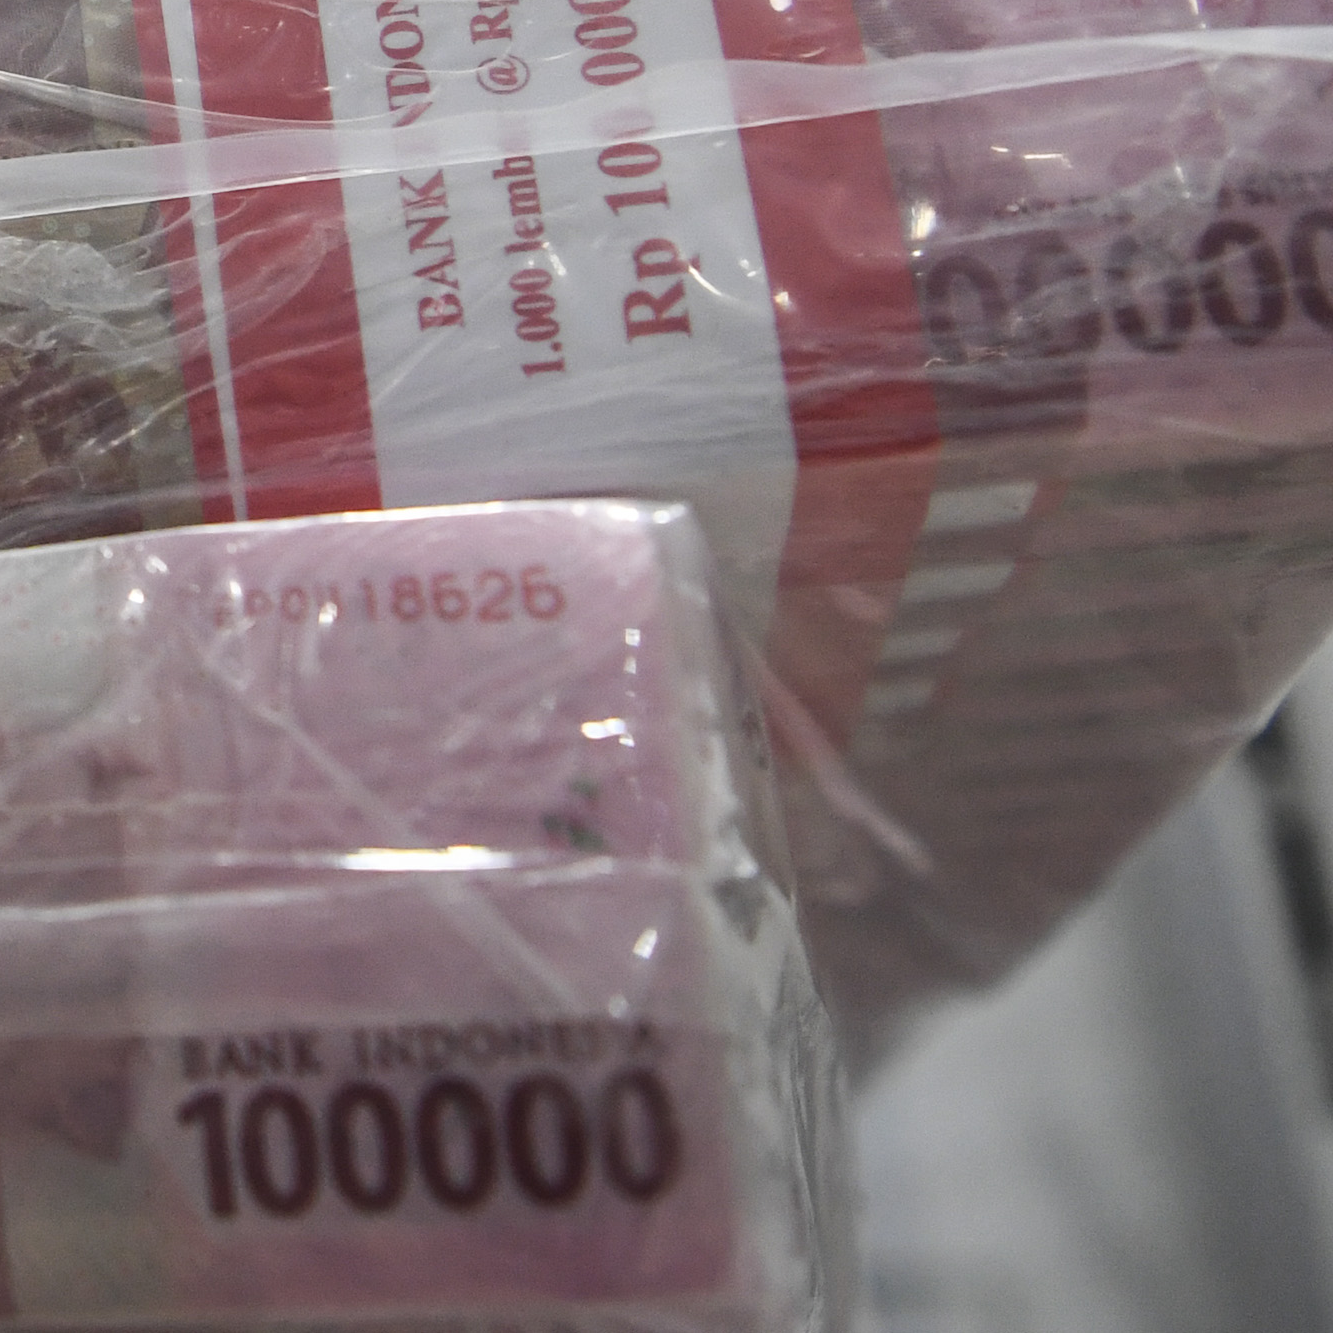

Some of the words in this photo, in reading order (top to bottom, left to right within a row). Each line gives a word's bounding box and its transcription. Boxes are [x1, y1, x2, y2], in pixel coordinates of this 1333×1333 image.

[476, 53, 531, 95] @
[490, 121, 546, 254] lemb
[397, 169, 465, 333] BANK
[620, 236, 702, 345] Rp
[509, 268, 567, 377] 1.000
[179, 1028, 323, 1079] BANK
[175, 1067, 680, 1220] 100000
